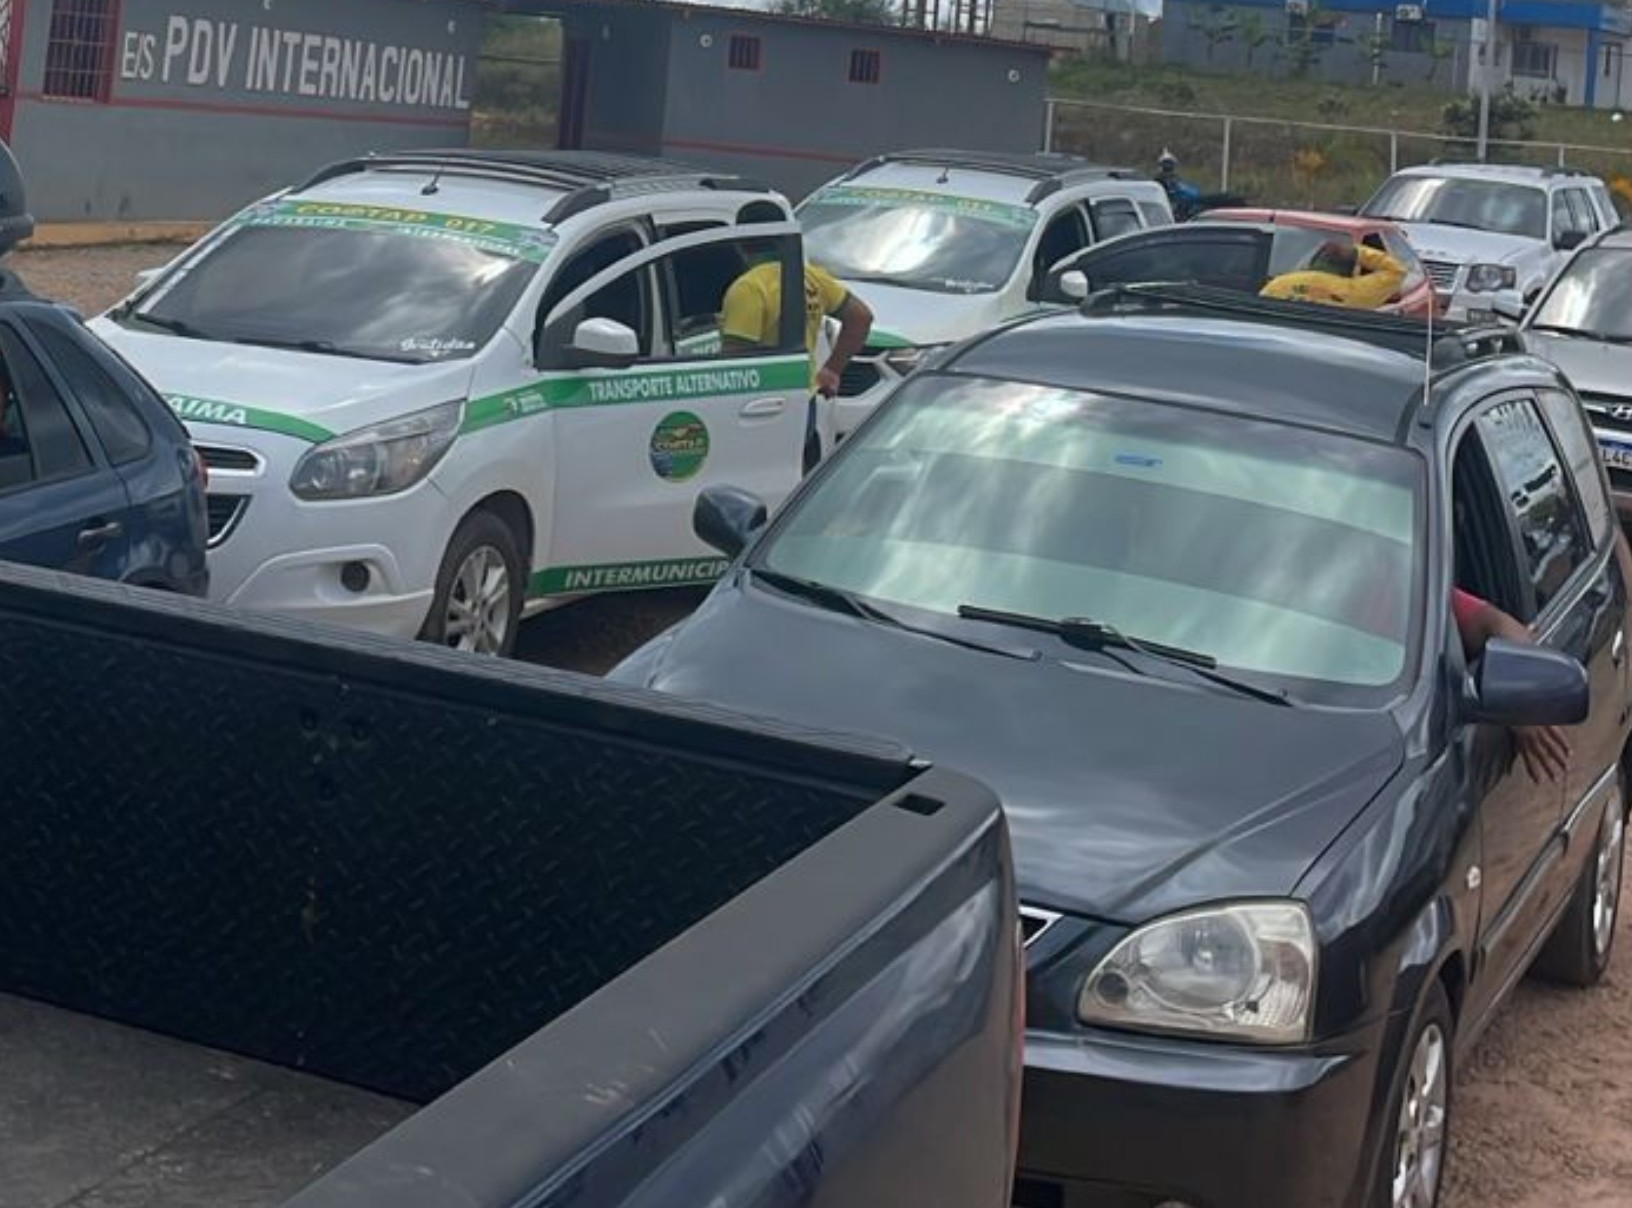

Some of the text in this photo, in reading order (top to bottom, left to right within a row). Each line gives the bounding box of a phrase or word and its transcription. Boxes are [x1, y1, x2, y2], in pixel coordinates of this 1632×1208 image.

[161, 15, 238, 89] PDV
[245, 27, 470, 109] INTERNACIONAL
[588, 369, 760, 402] TRANSPORTE ALTERNATIVO
